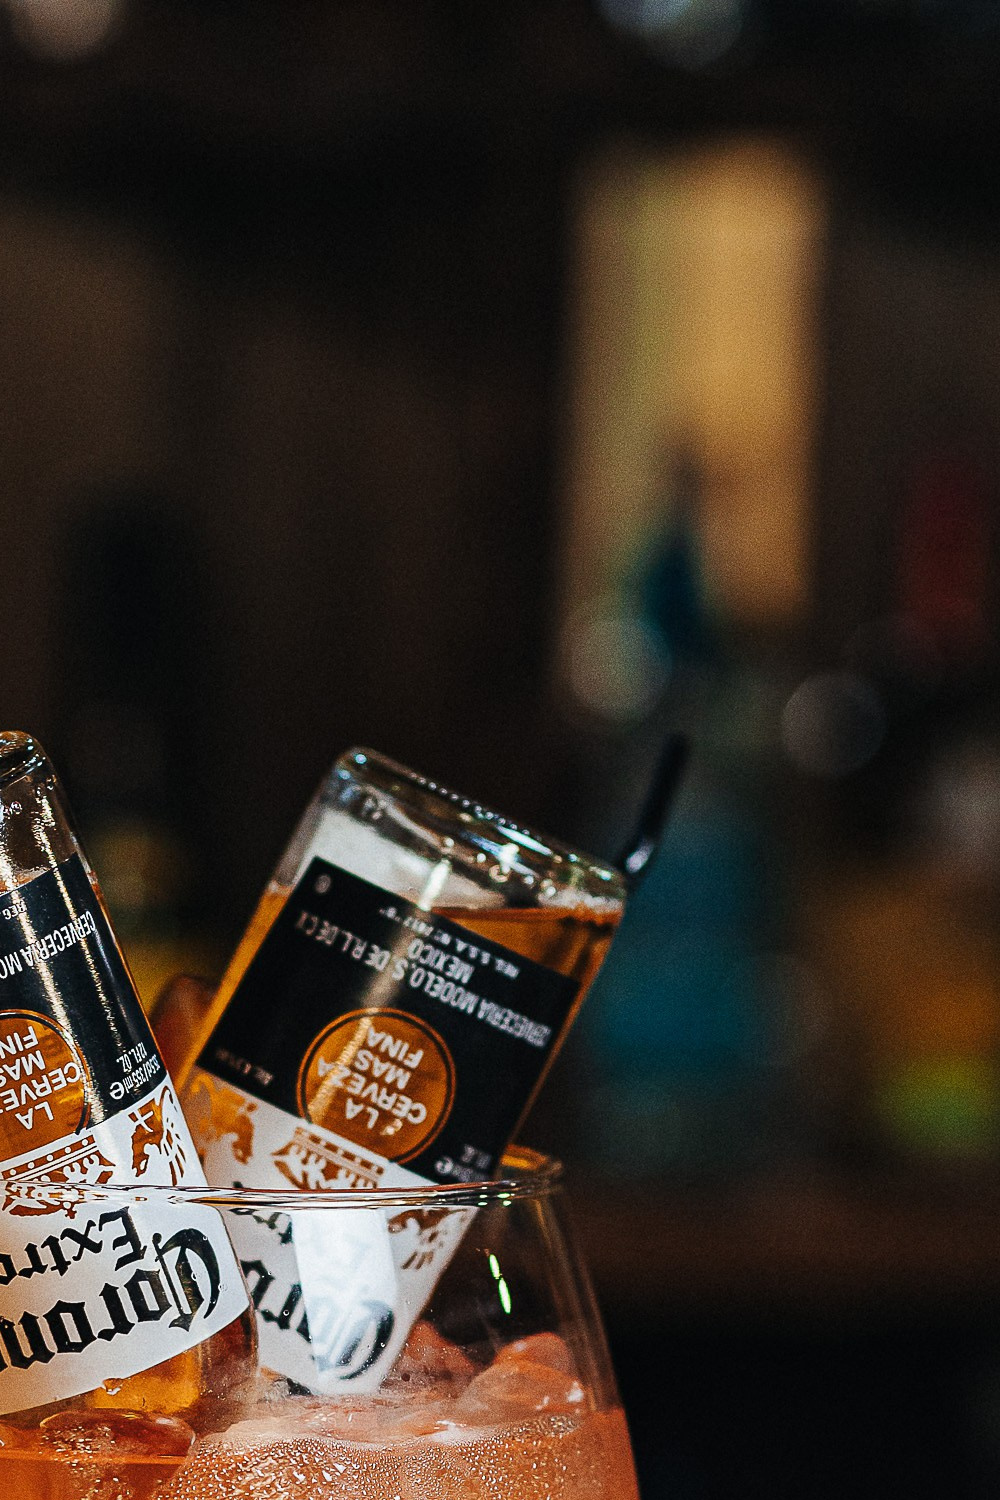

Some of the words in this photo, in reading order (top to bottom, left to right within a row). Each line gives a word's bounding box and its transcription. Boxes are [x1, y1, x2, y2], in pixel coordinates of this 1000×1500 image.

[20, 910, 96, 967] CERVECERIA
[364, 944, 390, 971] DE
[407, 938, 474, 984] MEXICO
[367, 1026, 424, 1068] FINA
[317, 1056, 427, 1124] CERVEZA
[354, 1049, 411, 1090] MAS
[15, 1101, 54, 1131] LA
[346, 1098, 379, 1129] LA
